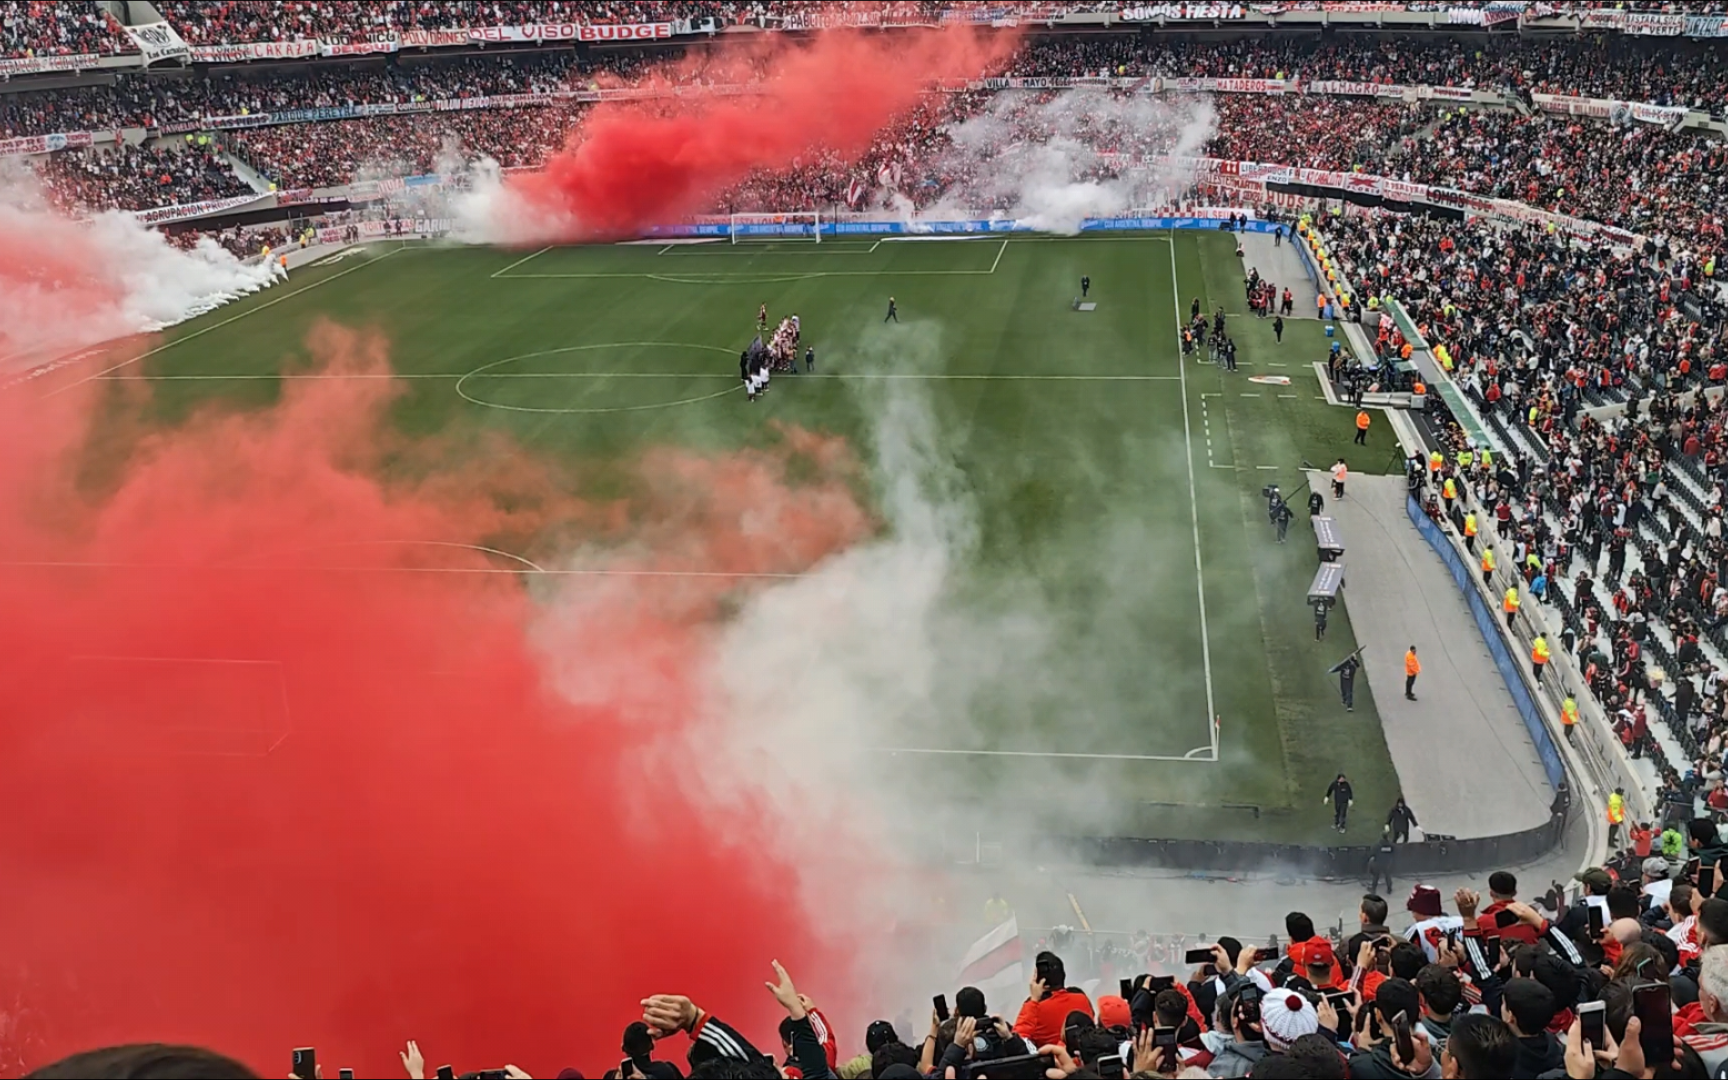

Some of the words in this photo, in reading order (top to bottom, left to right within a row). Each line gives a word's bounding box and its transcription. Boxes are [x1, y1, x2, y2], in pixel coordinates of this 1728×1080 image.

[1122, 5, 1182, 20] SOMOS
[1185, 4, 1242, 19] FIESTA
[401, 29, 468, 46] POLVORINES
[471, 28, 512, 41] DEL
[522, 25, 574, 39] VISO
[580, 25, 669, 40] BUDGE
[986, 78, 1009, 88] VILLA
[1022, 78, 1047, 87] MAYO
[1217, 79, 1266, 92] MATADEROS
[1322, 82, 1380, 95] ALMAGRO
[1426, 188, 1465, 209] LOMAS
[146, 204, 203, 223] AGRUPACION
